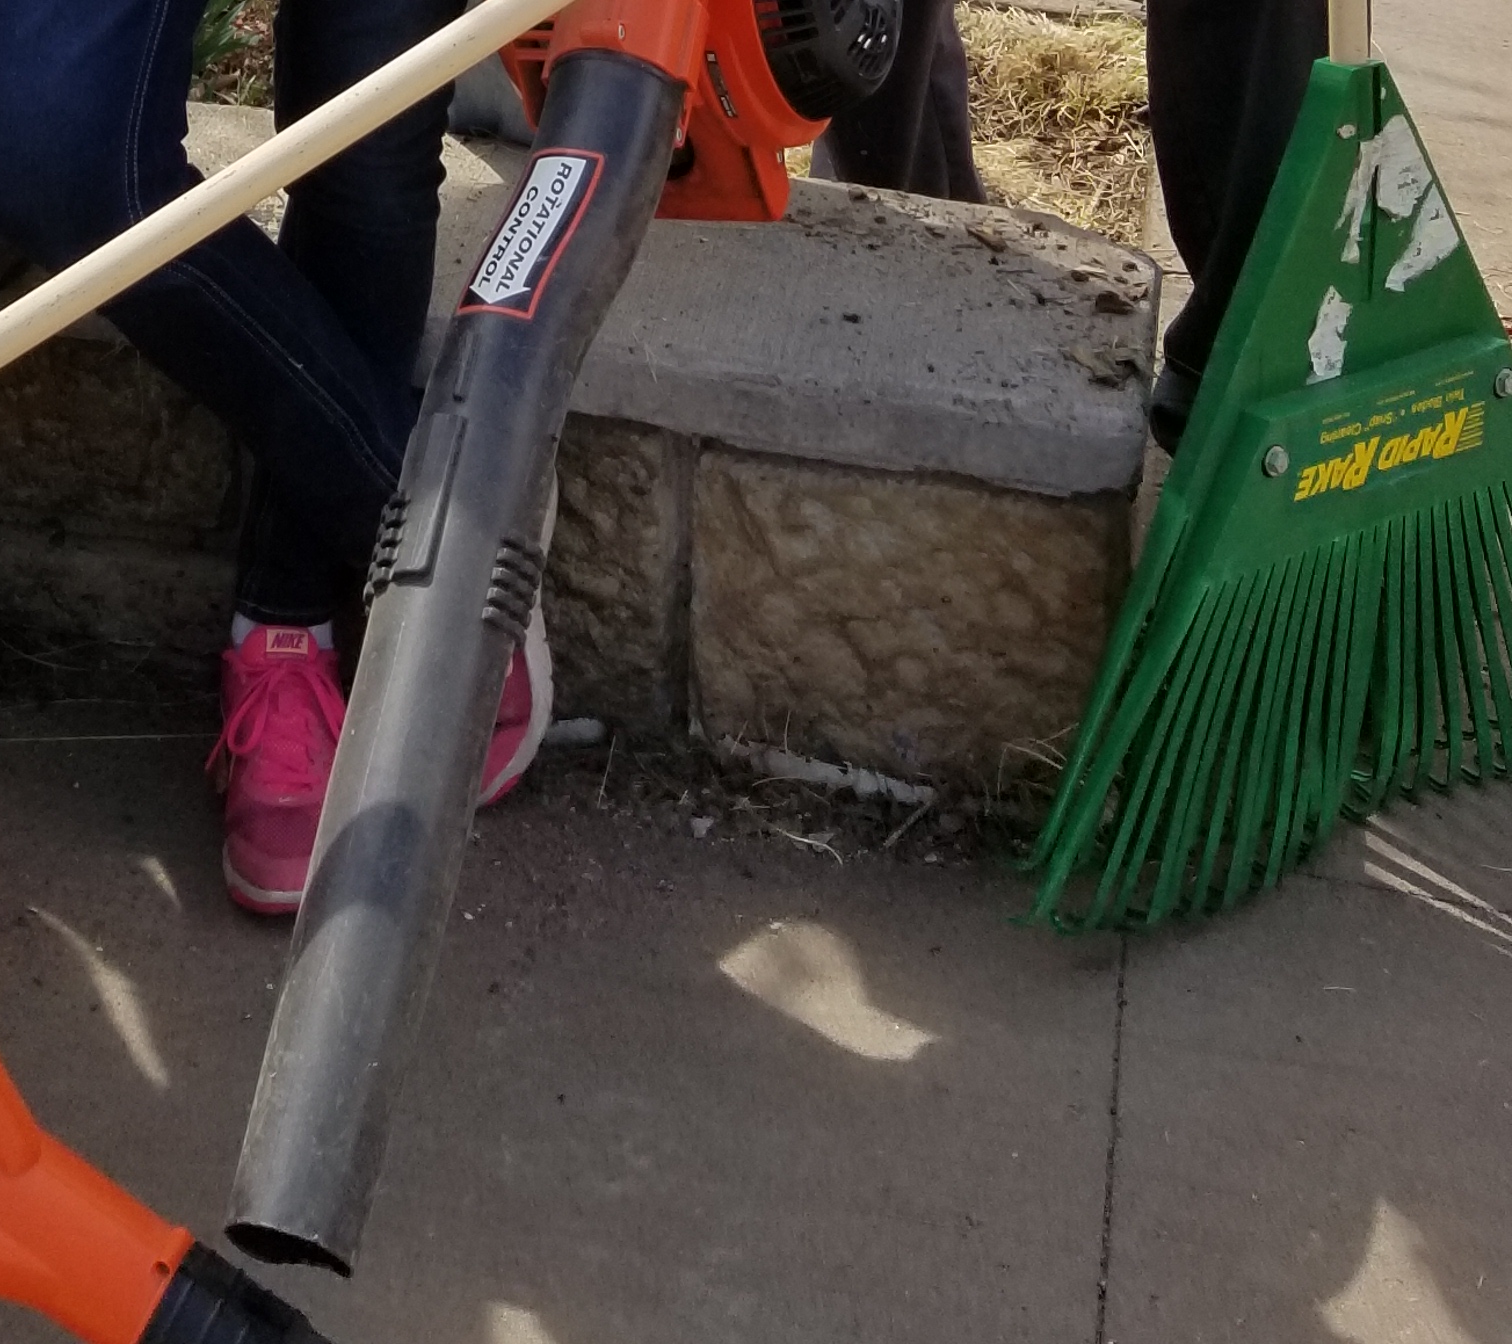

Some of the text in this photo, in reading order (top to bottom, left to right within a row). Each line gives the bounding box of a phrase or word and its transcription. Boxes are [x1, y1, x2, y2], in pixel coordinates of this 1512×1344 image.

[477, 186, 539, 289] CONTROL
[495, 162, 573, 294] ROTATIONAL
[1293, 406, 1470, 503] RAPID RAKE
[270, 631, 305, 651] NIKE
